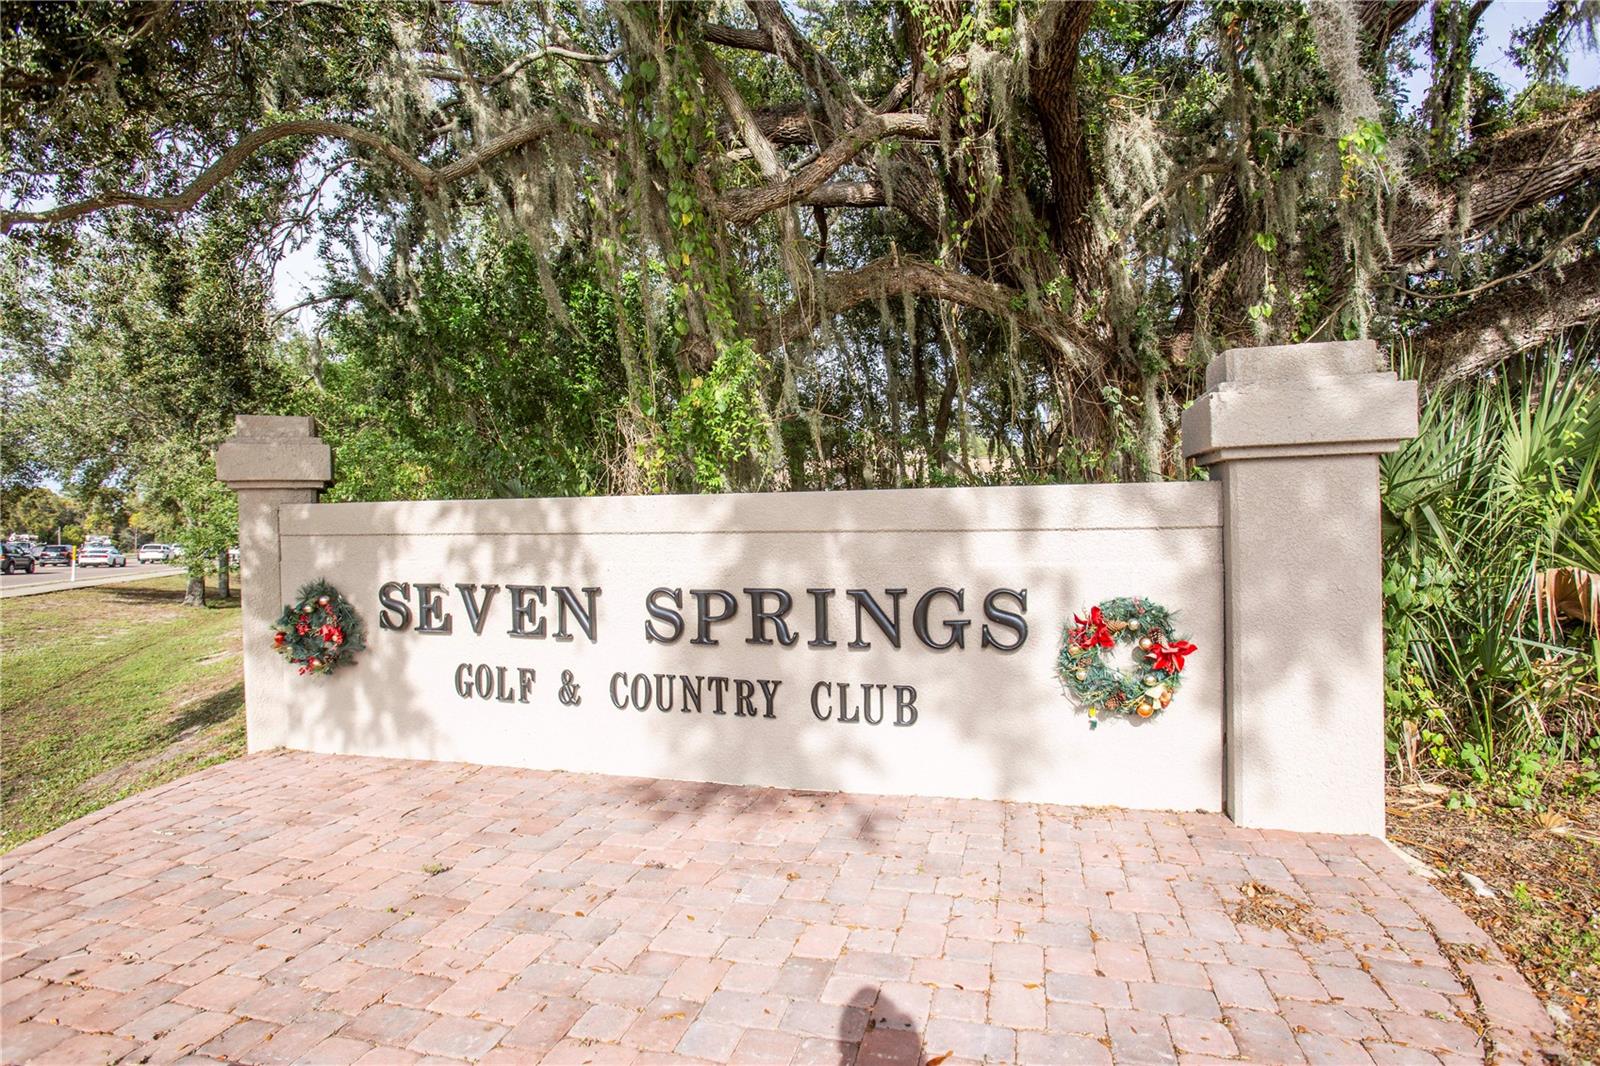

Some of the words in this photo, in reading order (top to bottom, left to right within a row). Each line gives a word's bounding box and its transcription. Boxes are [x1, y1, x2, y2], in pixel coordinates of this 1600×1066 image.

[378, 581, 602, 643] SEVEN
[645, 587, 1029, 653] SPRINGS
[454, 663, 536, 704] GOLF
[558, 669, 581, 706] &
[609, 671, 782, 719] COUNTRY
[810, 681, 919, 727] CLUB
